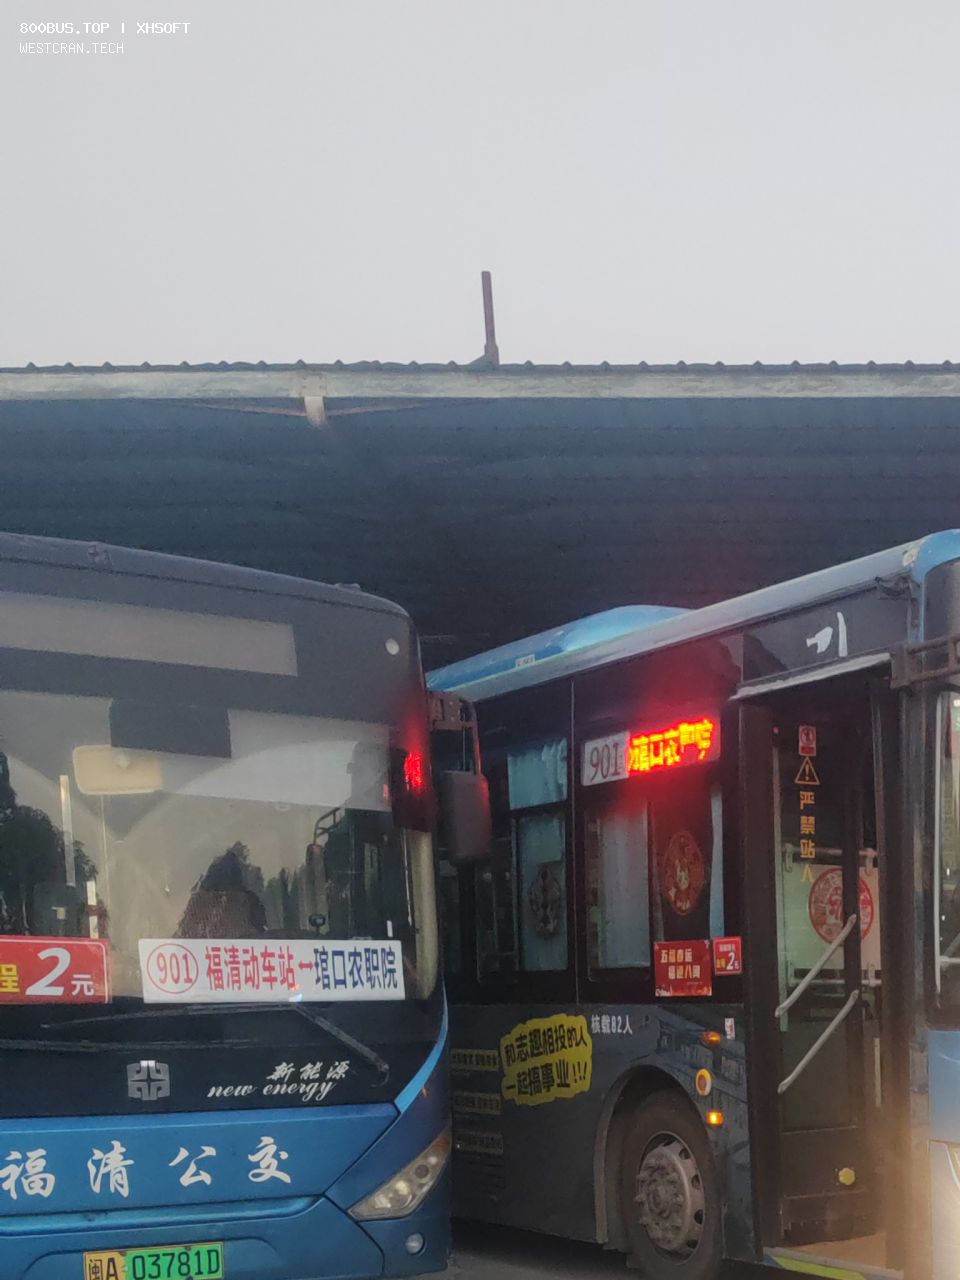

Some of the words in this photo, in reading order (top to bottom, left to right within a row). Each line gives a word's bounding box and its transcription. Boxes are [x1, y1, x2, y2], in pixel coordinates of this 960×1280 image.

[590, 742, 621, 782] 901
[157, 952, 193, 985] 901
[205, 946, 297, 991] 福清动车站
[591, 1014, 634, 1035] 核载82人
[266, 1060, 350, 1080] 新能源
[207, 1085, 258, 1097] new
[263, 1081, 337, 1102] energy
[132, 1249, 221, 1280] 03781D
